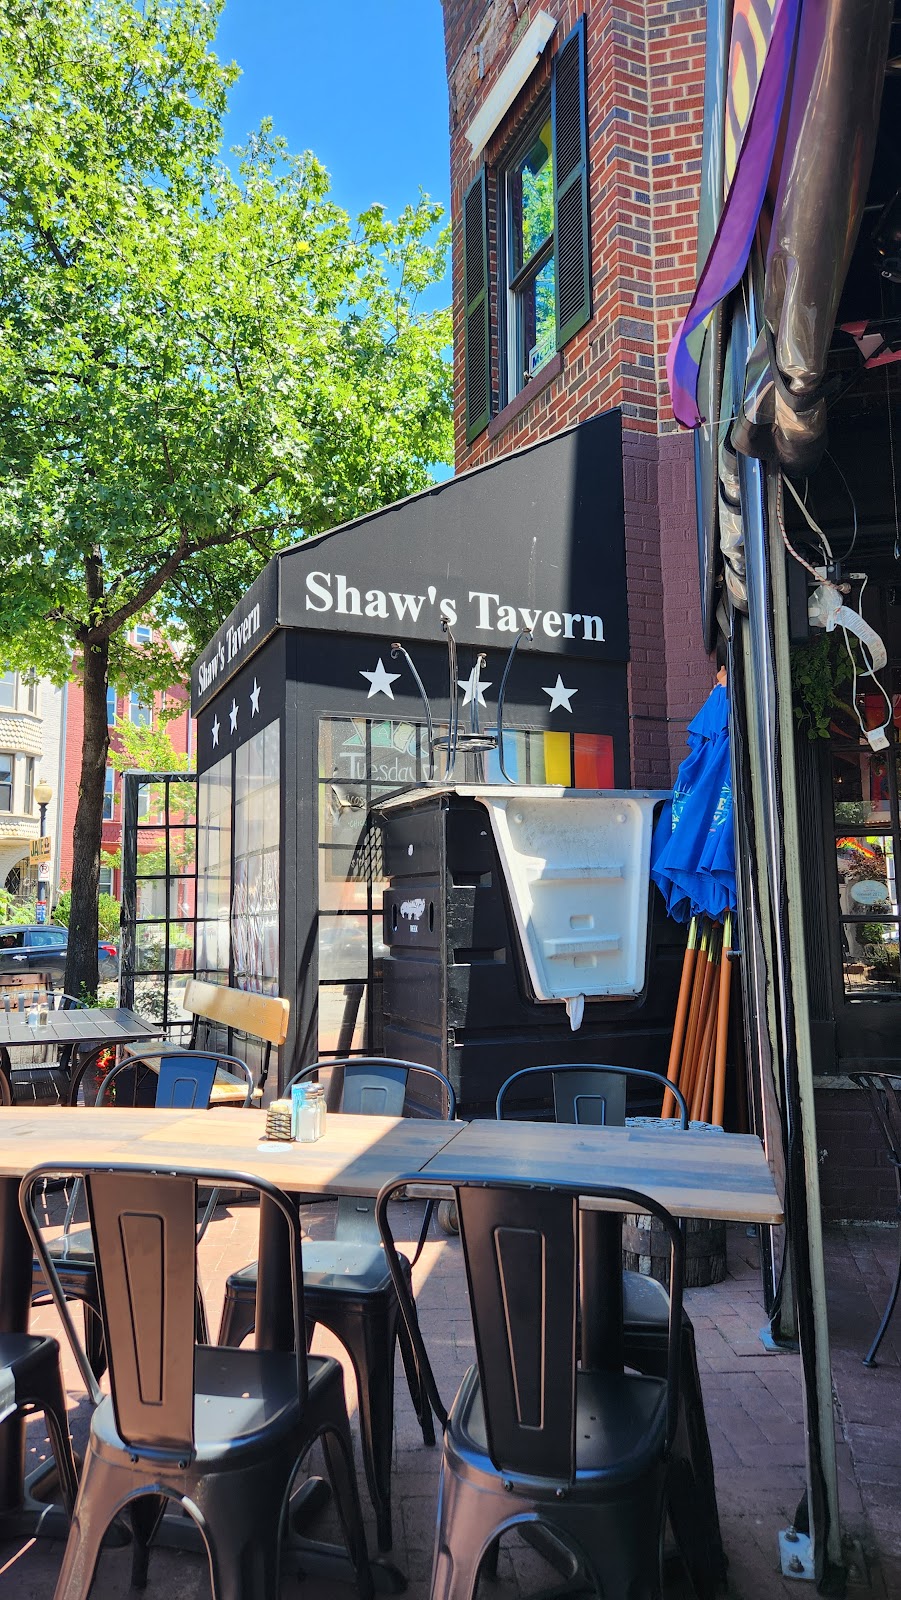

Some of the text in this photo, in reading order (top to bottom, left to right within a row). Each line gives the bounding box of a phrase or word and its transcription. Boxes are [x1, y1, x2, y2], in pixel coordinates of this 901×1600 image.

[305, 571, 606, 642] Shaw's Tavern
[198, 603, 260, 697] Shaw's Tavern
